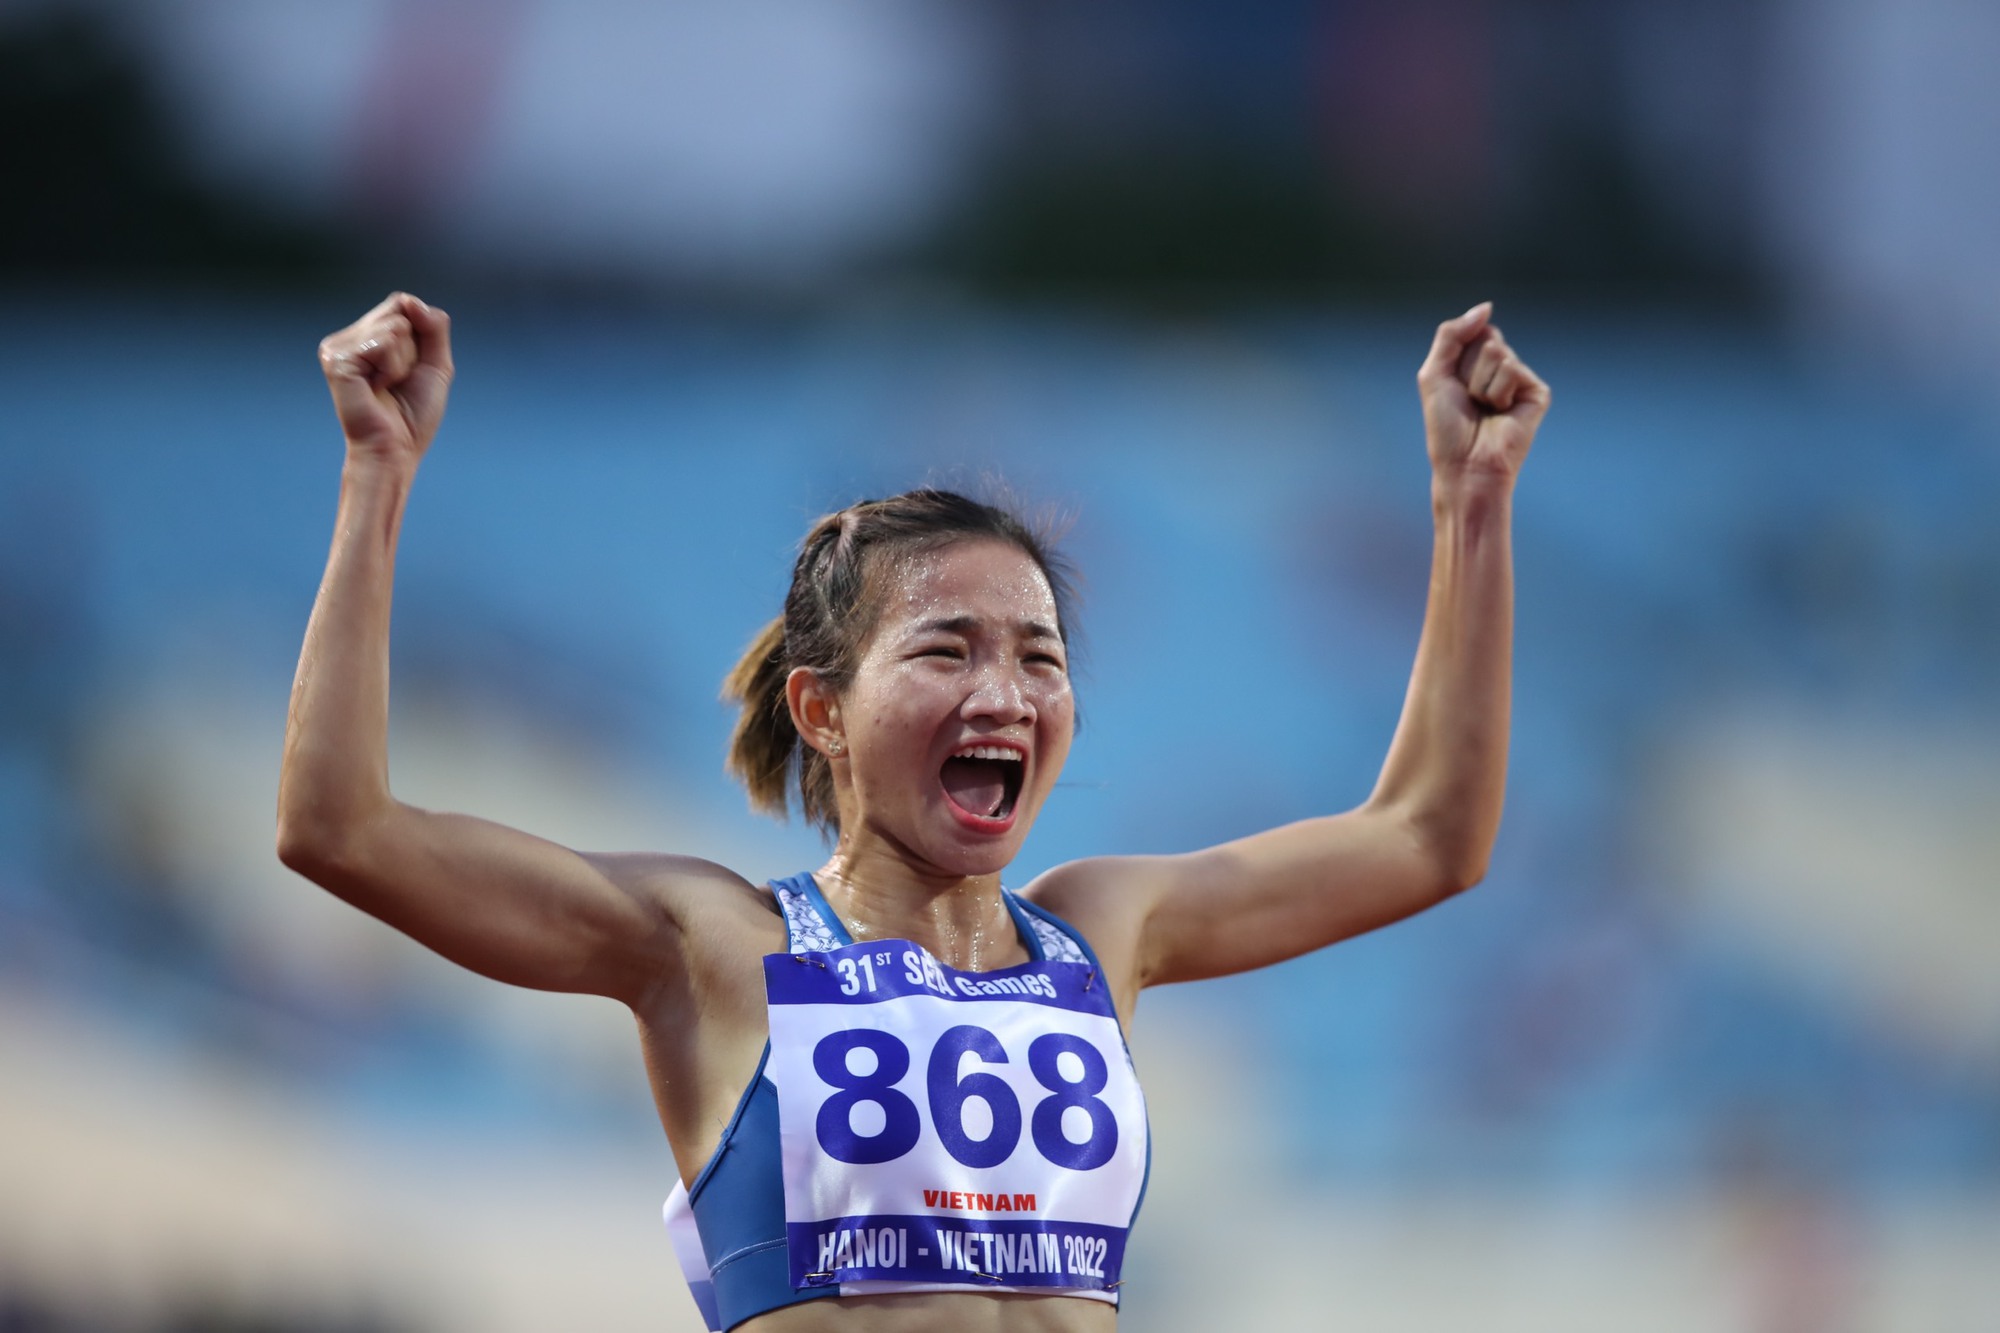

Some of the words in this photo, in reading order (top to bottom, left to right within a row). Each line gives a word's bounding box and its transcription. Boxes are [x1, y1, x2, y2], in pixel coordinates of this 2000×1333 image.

[902, 950, 958, 997] SEA
[953, 972, 1058, 999] Games
[812, 1024, 1119, 1171] 868
[923, 1189, 1037, 1212] VIETNAM
[817, 1227, 908, 1273] HANOI
[936, 1229, 1062, 1275] VIETNAM
[1063, 1234, 1108, 1279] 2022
